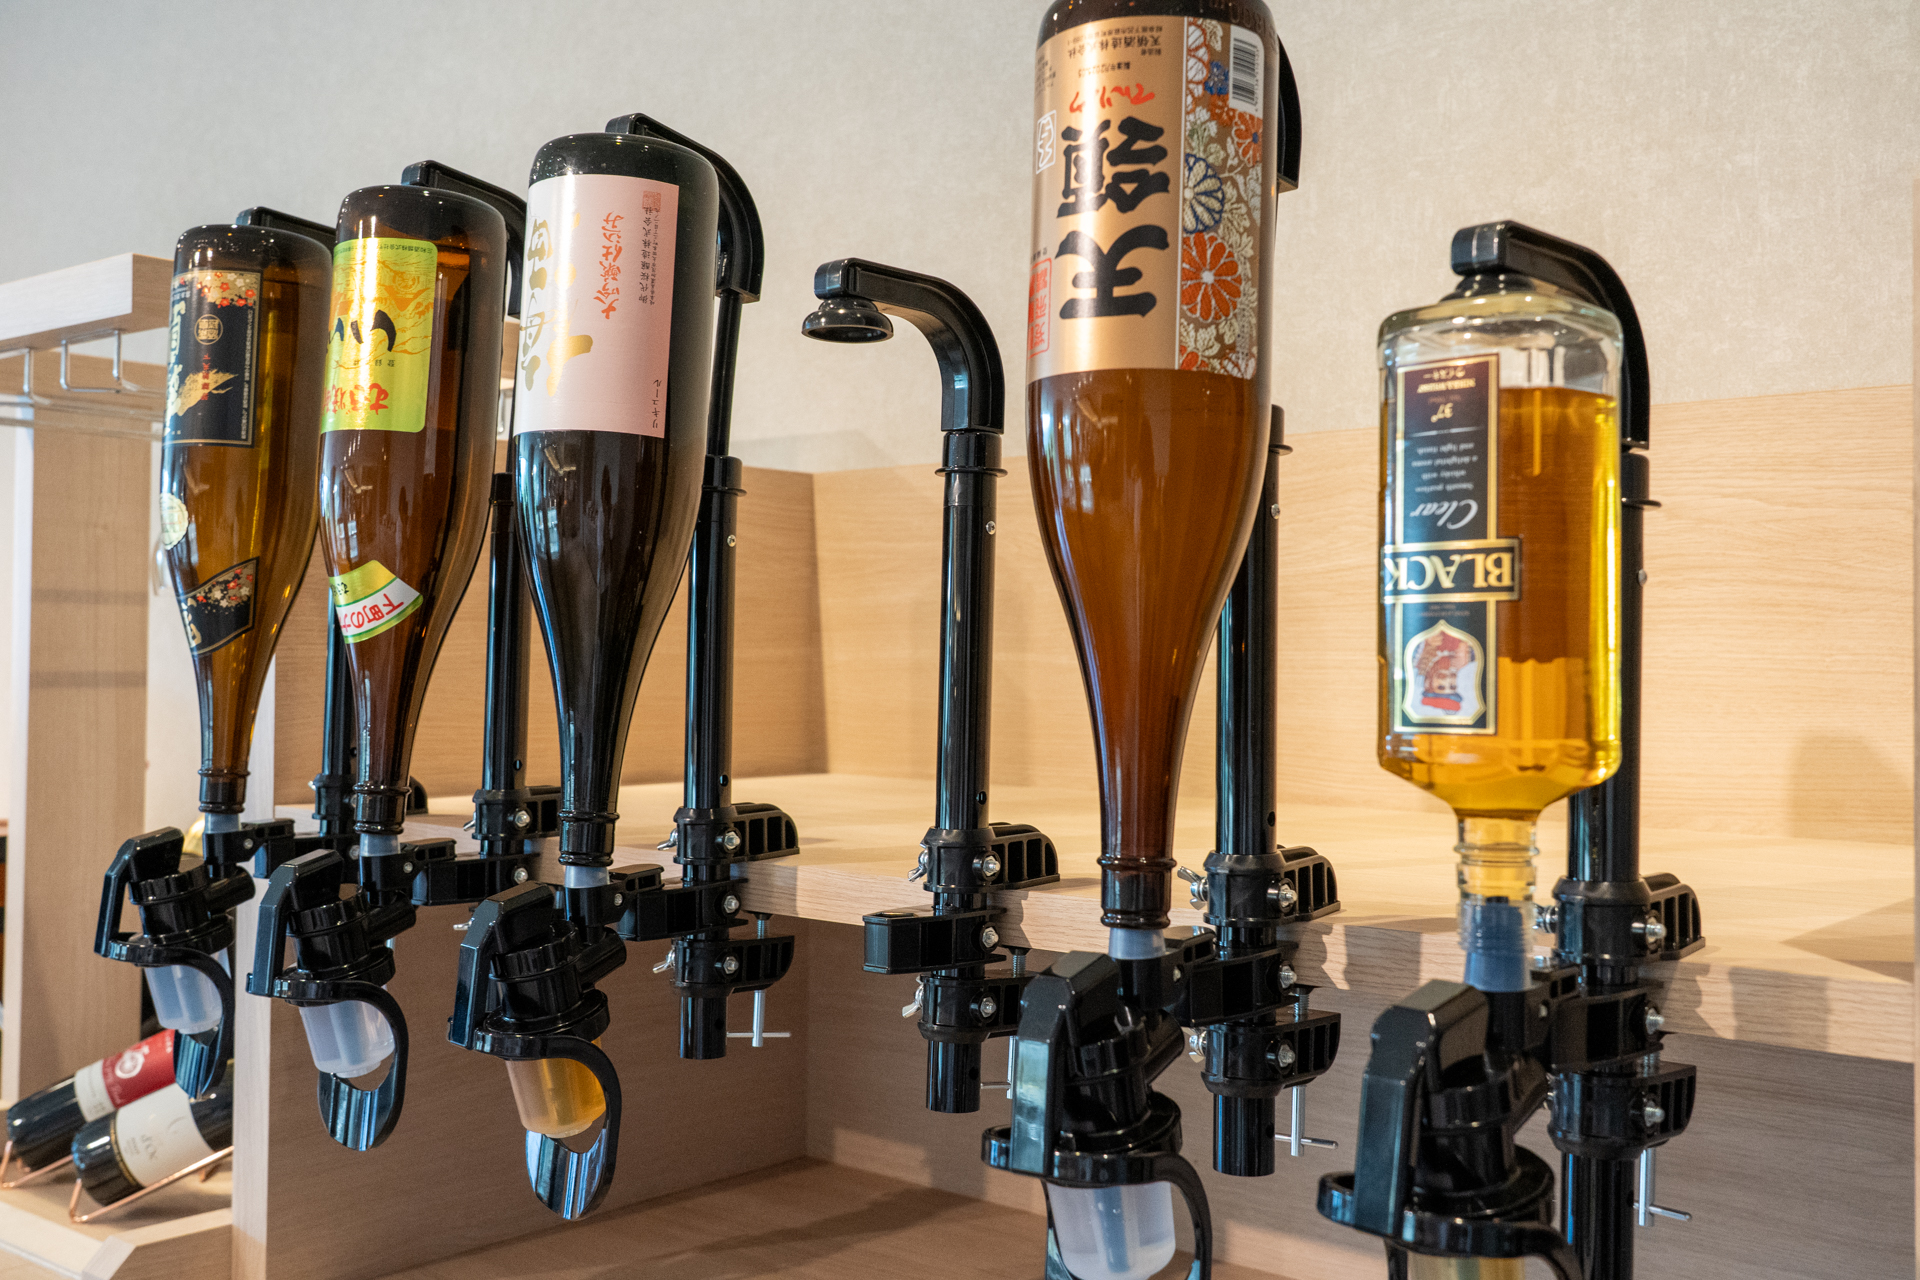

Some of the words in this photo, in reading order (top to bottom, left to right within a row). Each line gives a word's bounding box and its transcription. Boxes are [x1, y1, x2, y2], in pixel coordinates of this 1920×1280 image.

[1055, 116, 1171, 321] 天領
[592, 210, 625, 321] 大吟醸仕込み
[638, 207, 653, 305] 御代桜醸造株式会社
[651, 379, 662, 430] リキュール
[1409, 499, 1479, 530] Clear
[1383, 551, 1514, 591] BLACK
[338, 593, 405, 633] 下町のナ
